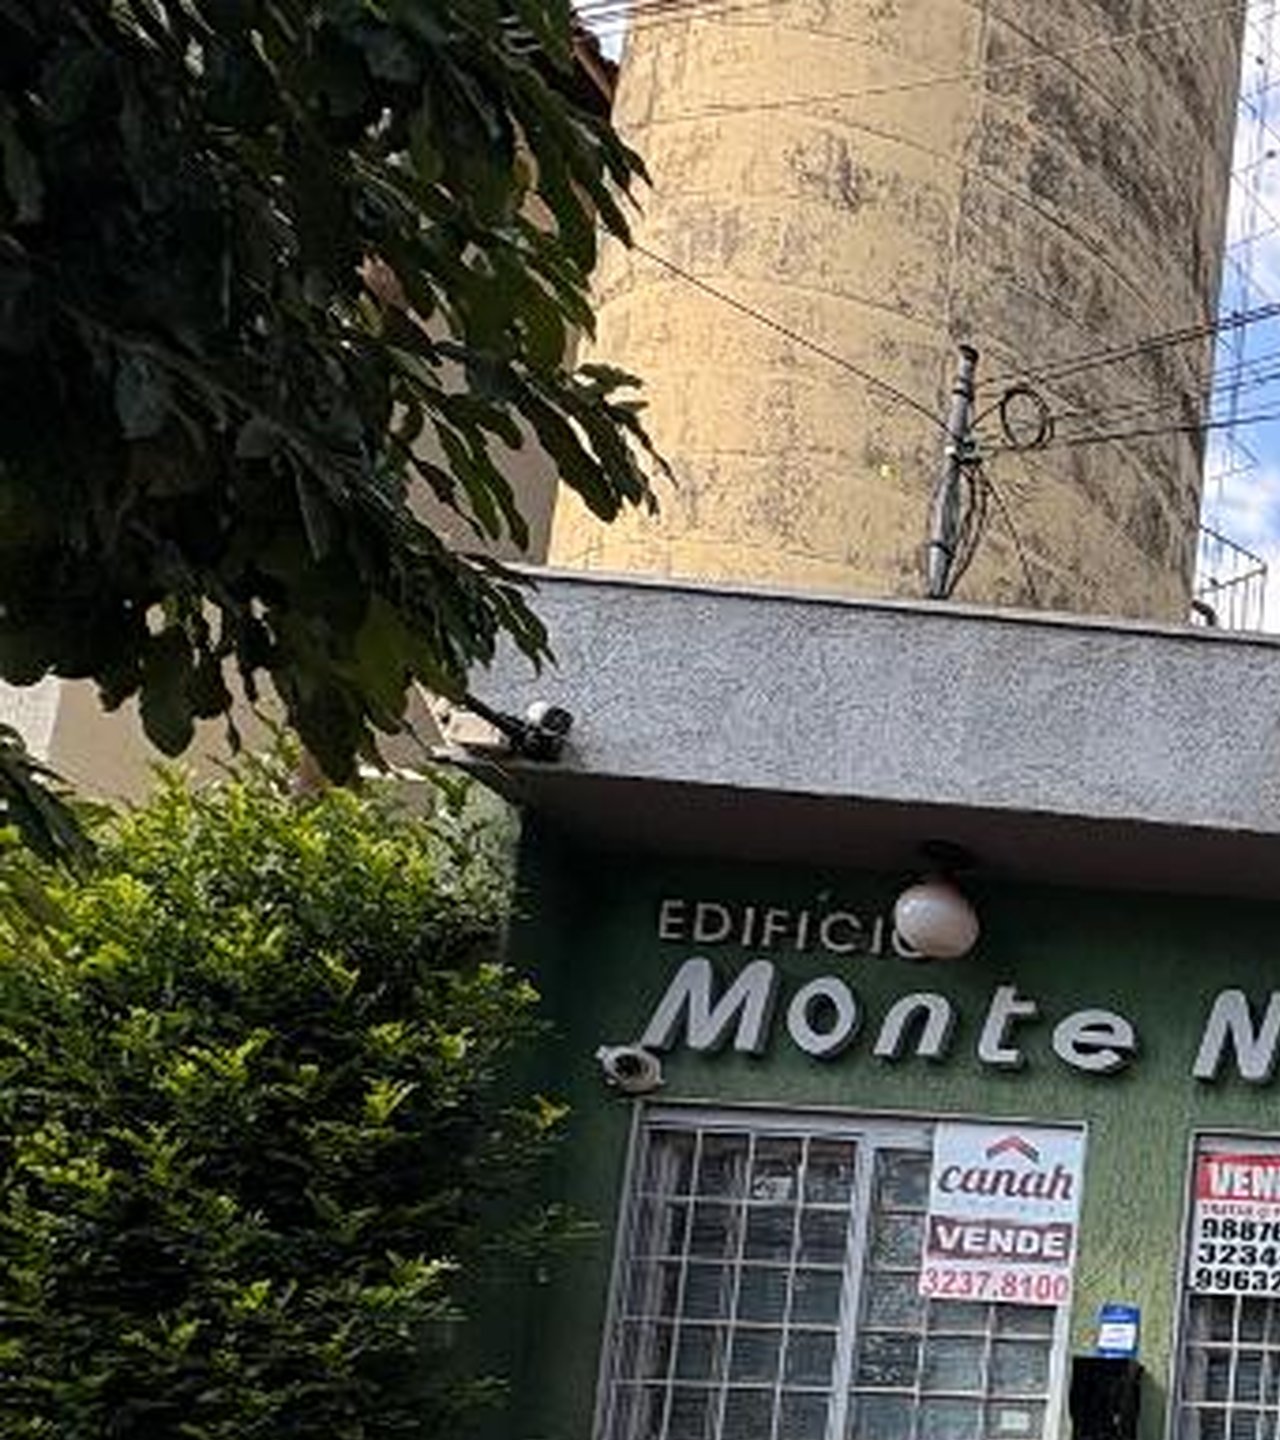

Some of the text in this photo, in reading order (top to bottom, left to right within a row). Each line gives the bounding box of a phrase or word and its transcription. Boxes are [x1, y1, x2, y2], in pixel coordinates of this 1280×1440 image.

[641, 955, 1138, 1076] Monte
[937, 1163, 1074, 1201] canah
[936, 1224, 1067, 1258] VENDE
[921, 1267, 1070, 1301] 3237.8100
